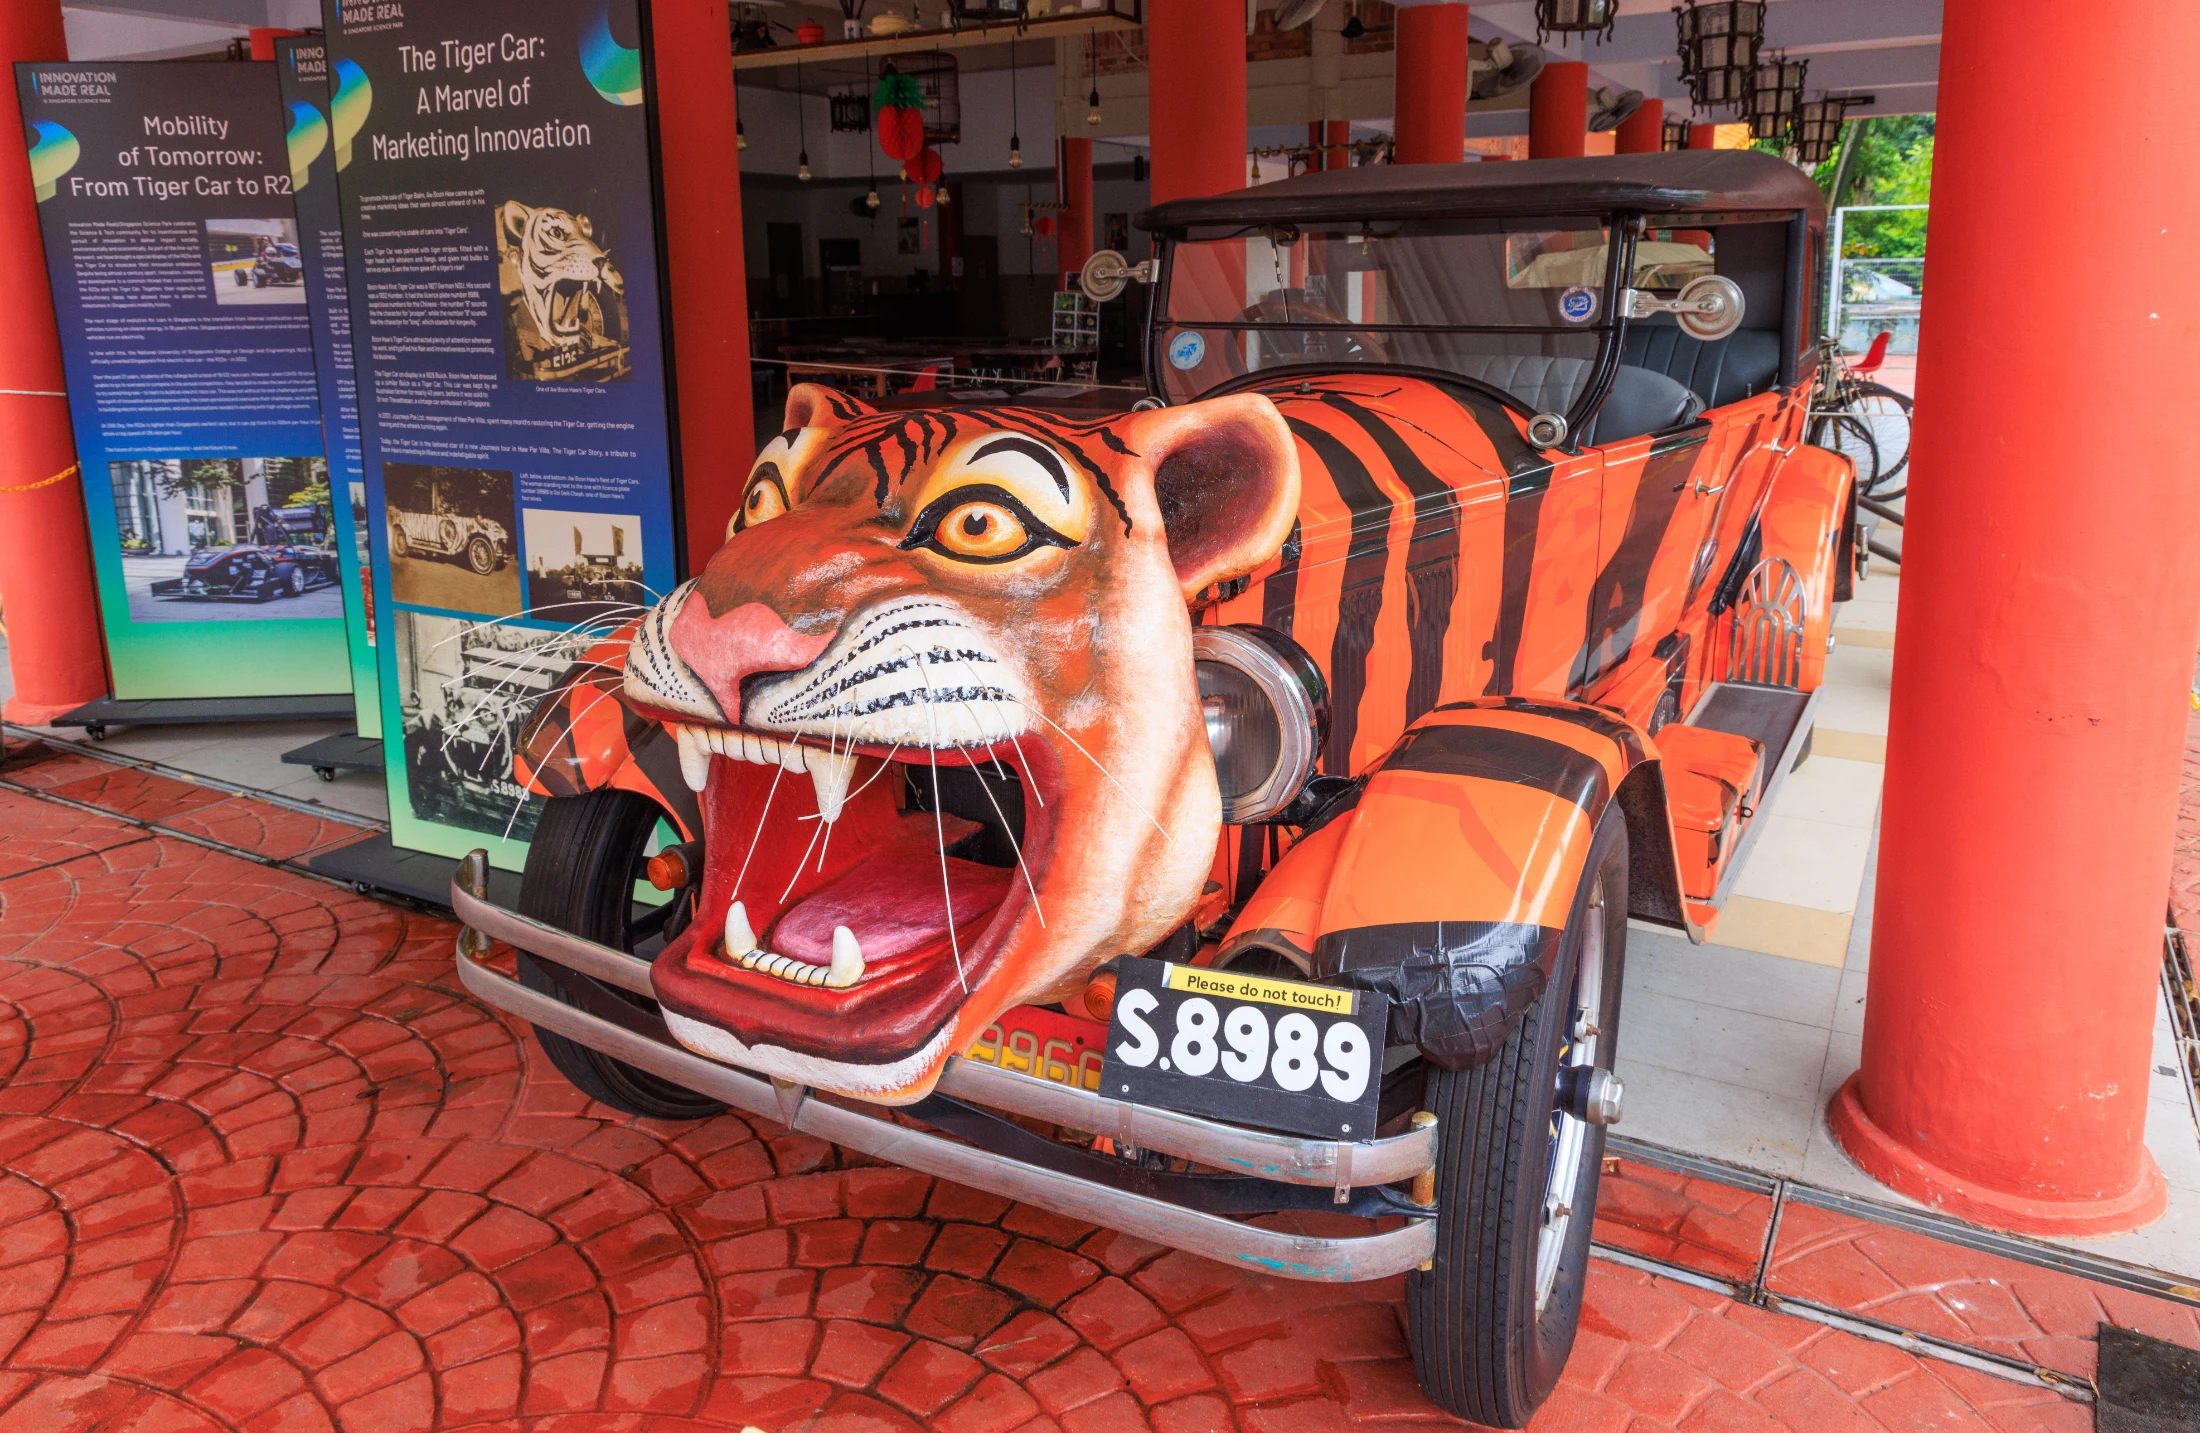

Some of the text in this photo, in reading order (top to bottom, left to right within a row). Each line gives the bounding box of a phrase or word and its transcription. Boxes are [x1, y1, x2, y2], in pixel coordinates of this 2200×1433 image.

[342, 6, 374, 24] MADE
[376, 2, 404, 19] REAL
[398, 32, 546, 73] The Tiger Car:
[39, 72, 117, 83] INNOVATION
[297, 60, 327, 73] MADE
[42, 84, 111, 95] MADE REAL
[416, 76, 531, 114] A Marvel of
[143, 115, 228, 140] Mobility
[372, 119, 591, 161] Marketing Innovation
[118, 146, 263, 166] of Tomorrow:
[70, 177, 128, 197] From
[133, 176, 190, 200] Tiger
[195, 176, 232, 196] Car
[238, 178, 259, 195] to
[1186, 974, 1342, 1010] Please do not touch!
[1114, 988, 1372, 1102] S.8989
